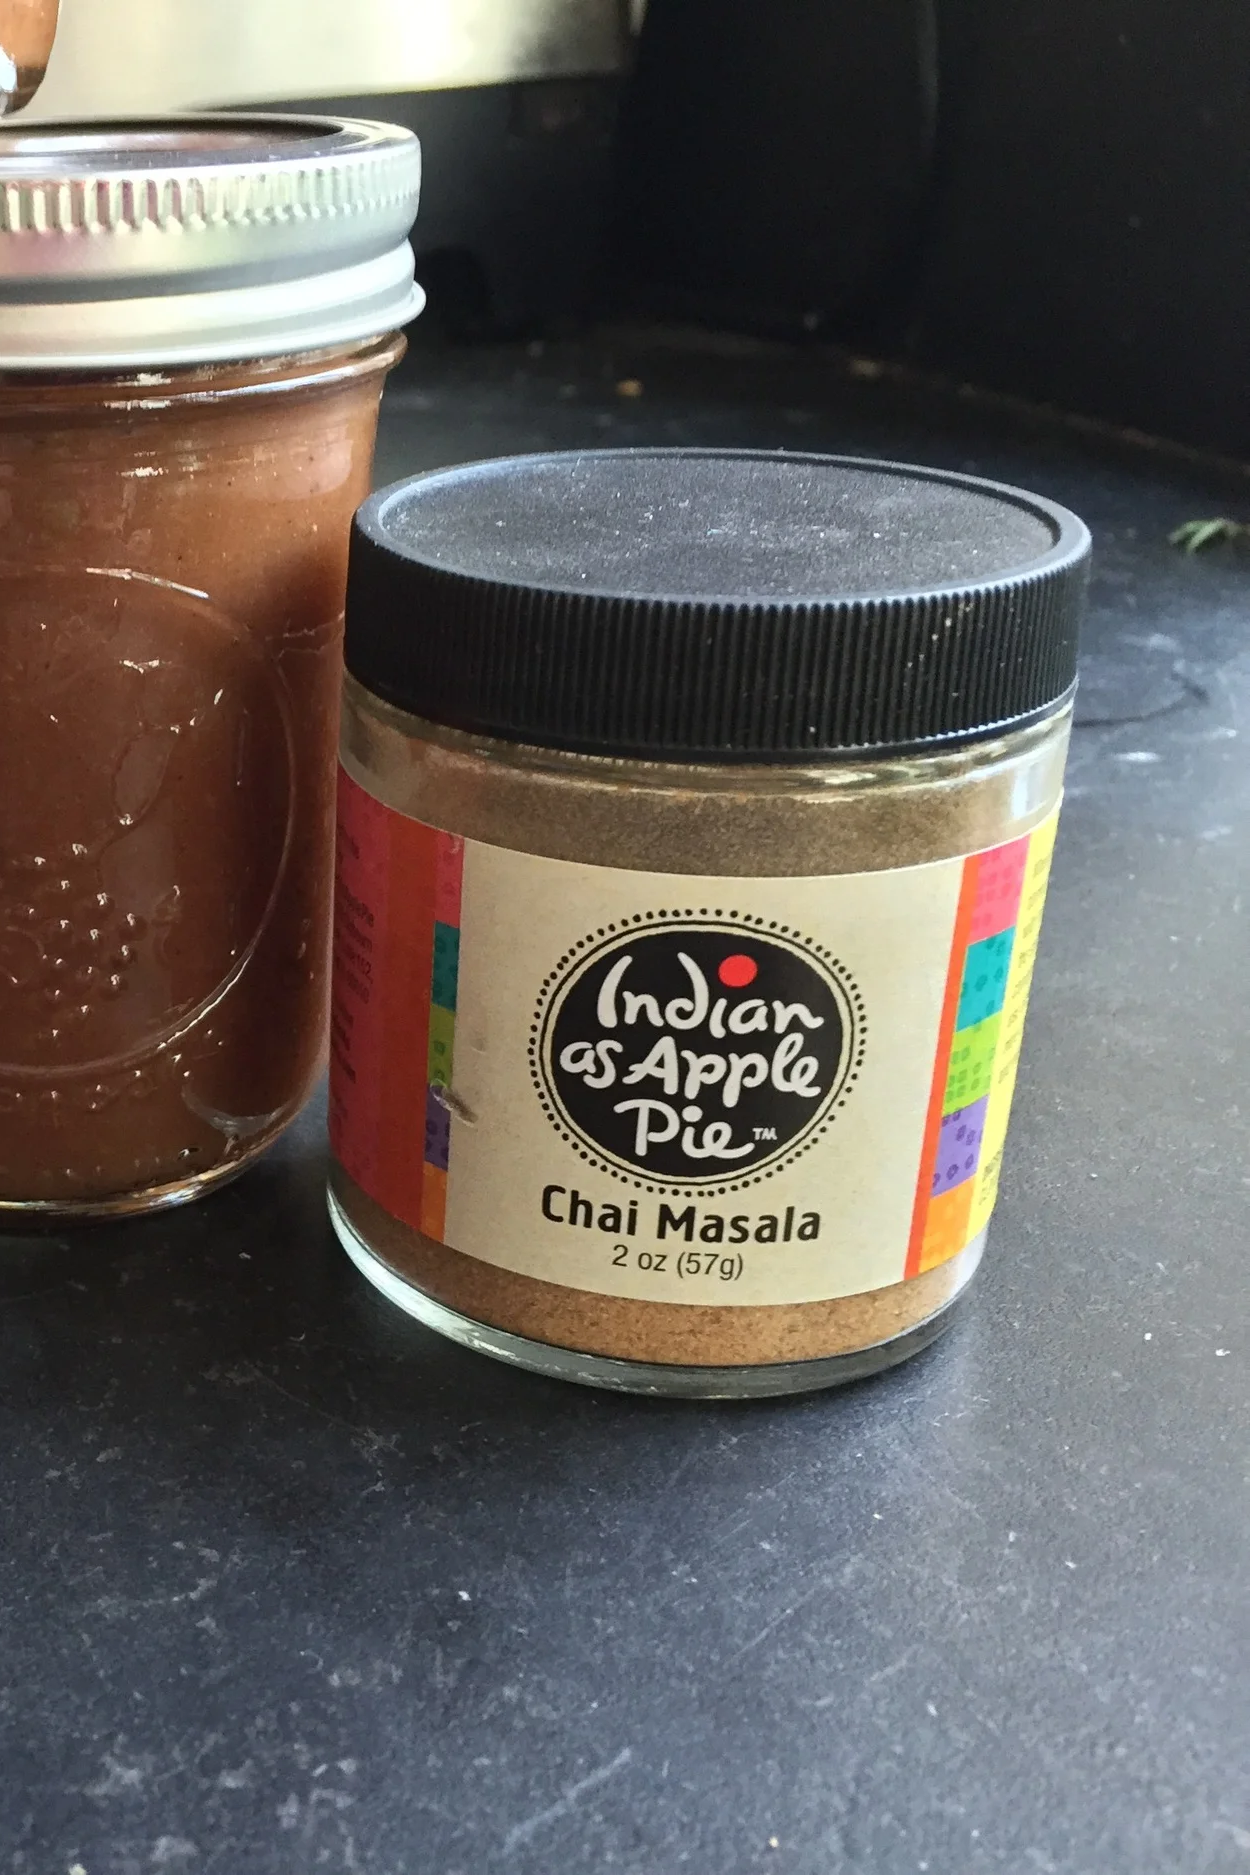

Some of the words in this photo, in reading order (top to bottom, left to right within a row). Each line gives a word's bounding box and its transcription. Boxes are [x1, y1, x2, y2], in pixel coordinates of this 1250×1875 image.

[597, 952, 824, 1038] Indian
[559, 1039, 624, 1089] as
[622, 1032, 822, 1108] Apple
[613, 1098, 755, 1160] Pie
[541, 1184, 639, 1236] Chai
[656, 1203, 822, 1244] Masala
[611, 1244, 629, 1267] 2
[637, 1254, 668, 1272] oz
[676, 1251, 744, 1281] (57g)
